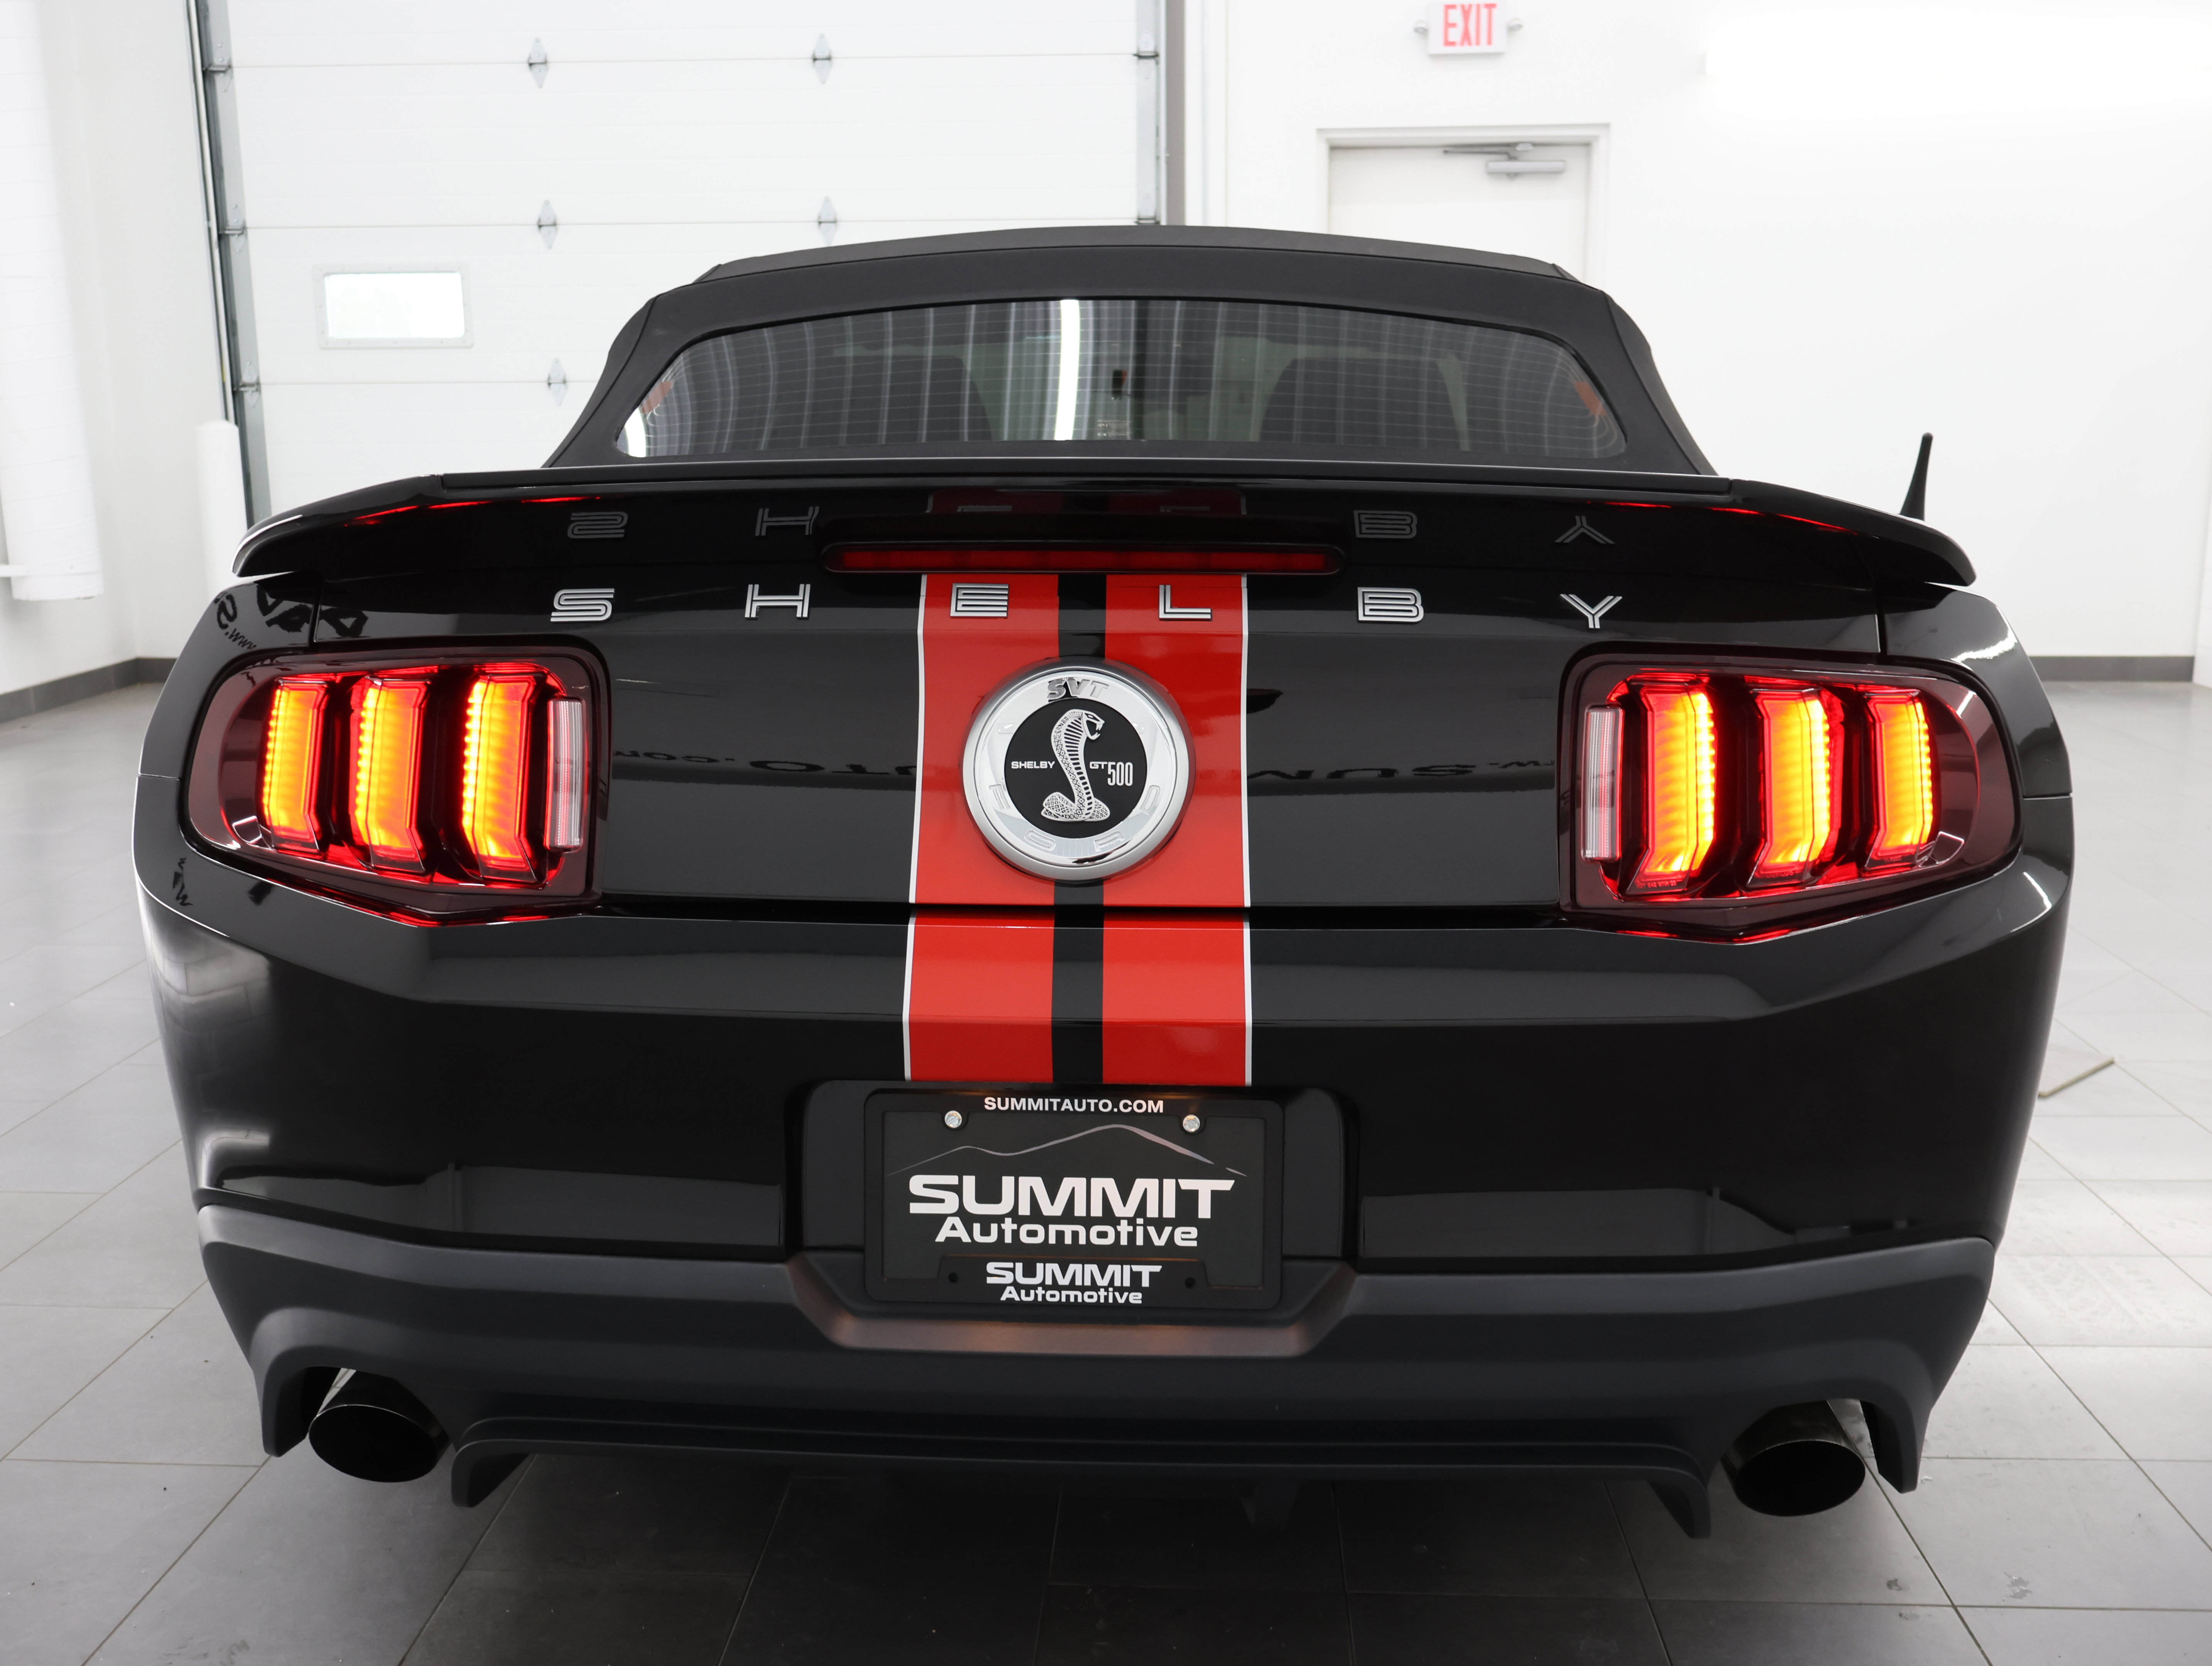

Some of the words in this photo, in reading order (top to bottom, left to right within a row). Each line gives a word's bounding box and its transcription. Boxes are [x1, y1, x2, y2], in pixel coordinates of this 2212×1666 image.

[1443, 3, 1497, 47] EXIT
[550, 583, 1623, 629] SHELBY
[1047, 678, 1109, 699] SVT
[1011, 761, 1056, 769] SHELBY
[984, 1097, 1163, 1113] SUMMITAUTO.COM
[909, 1174, 1235, 1219] SUMMIT
[935, 1216, 1198, 1247] Automotive
[986, 1261, 1162, 1287] SUMMIT
[1000, 1286, 1142, 1304] Automotive
